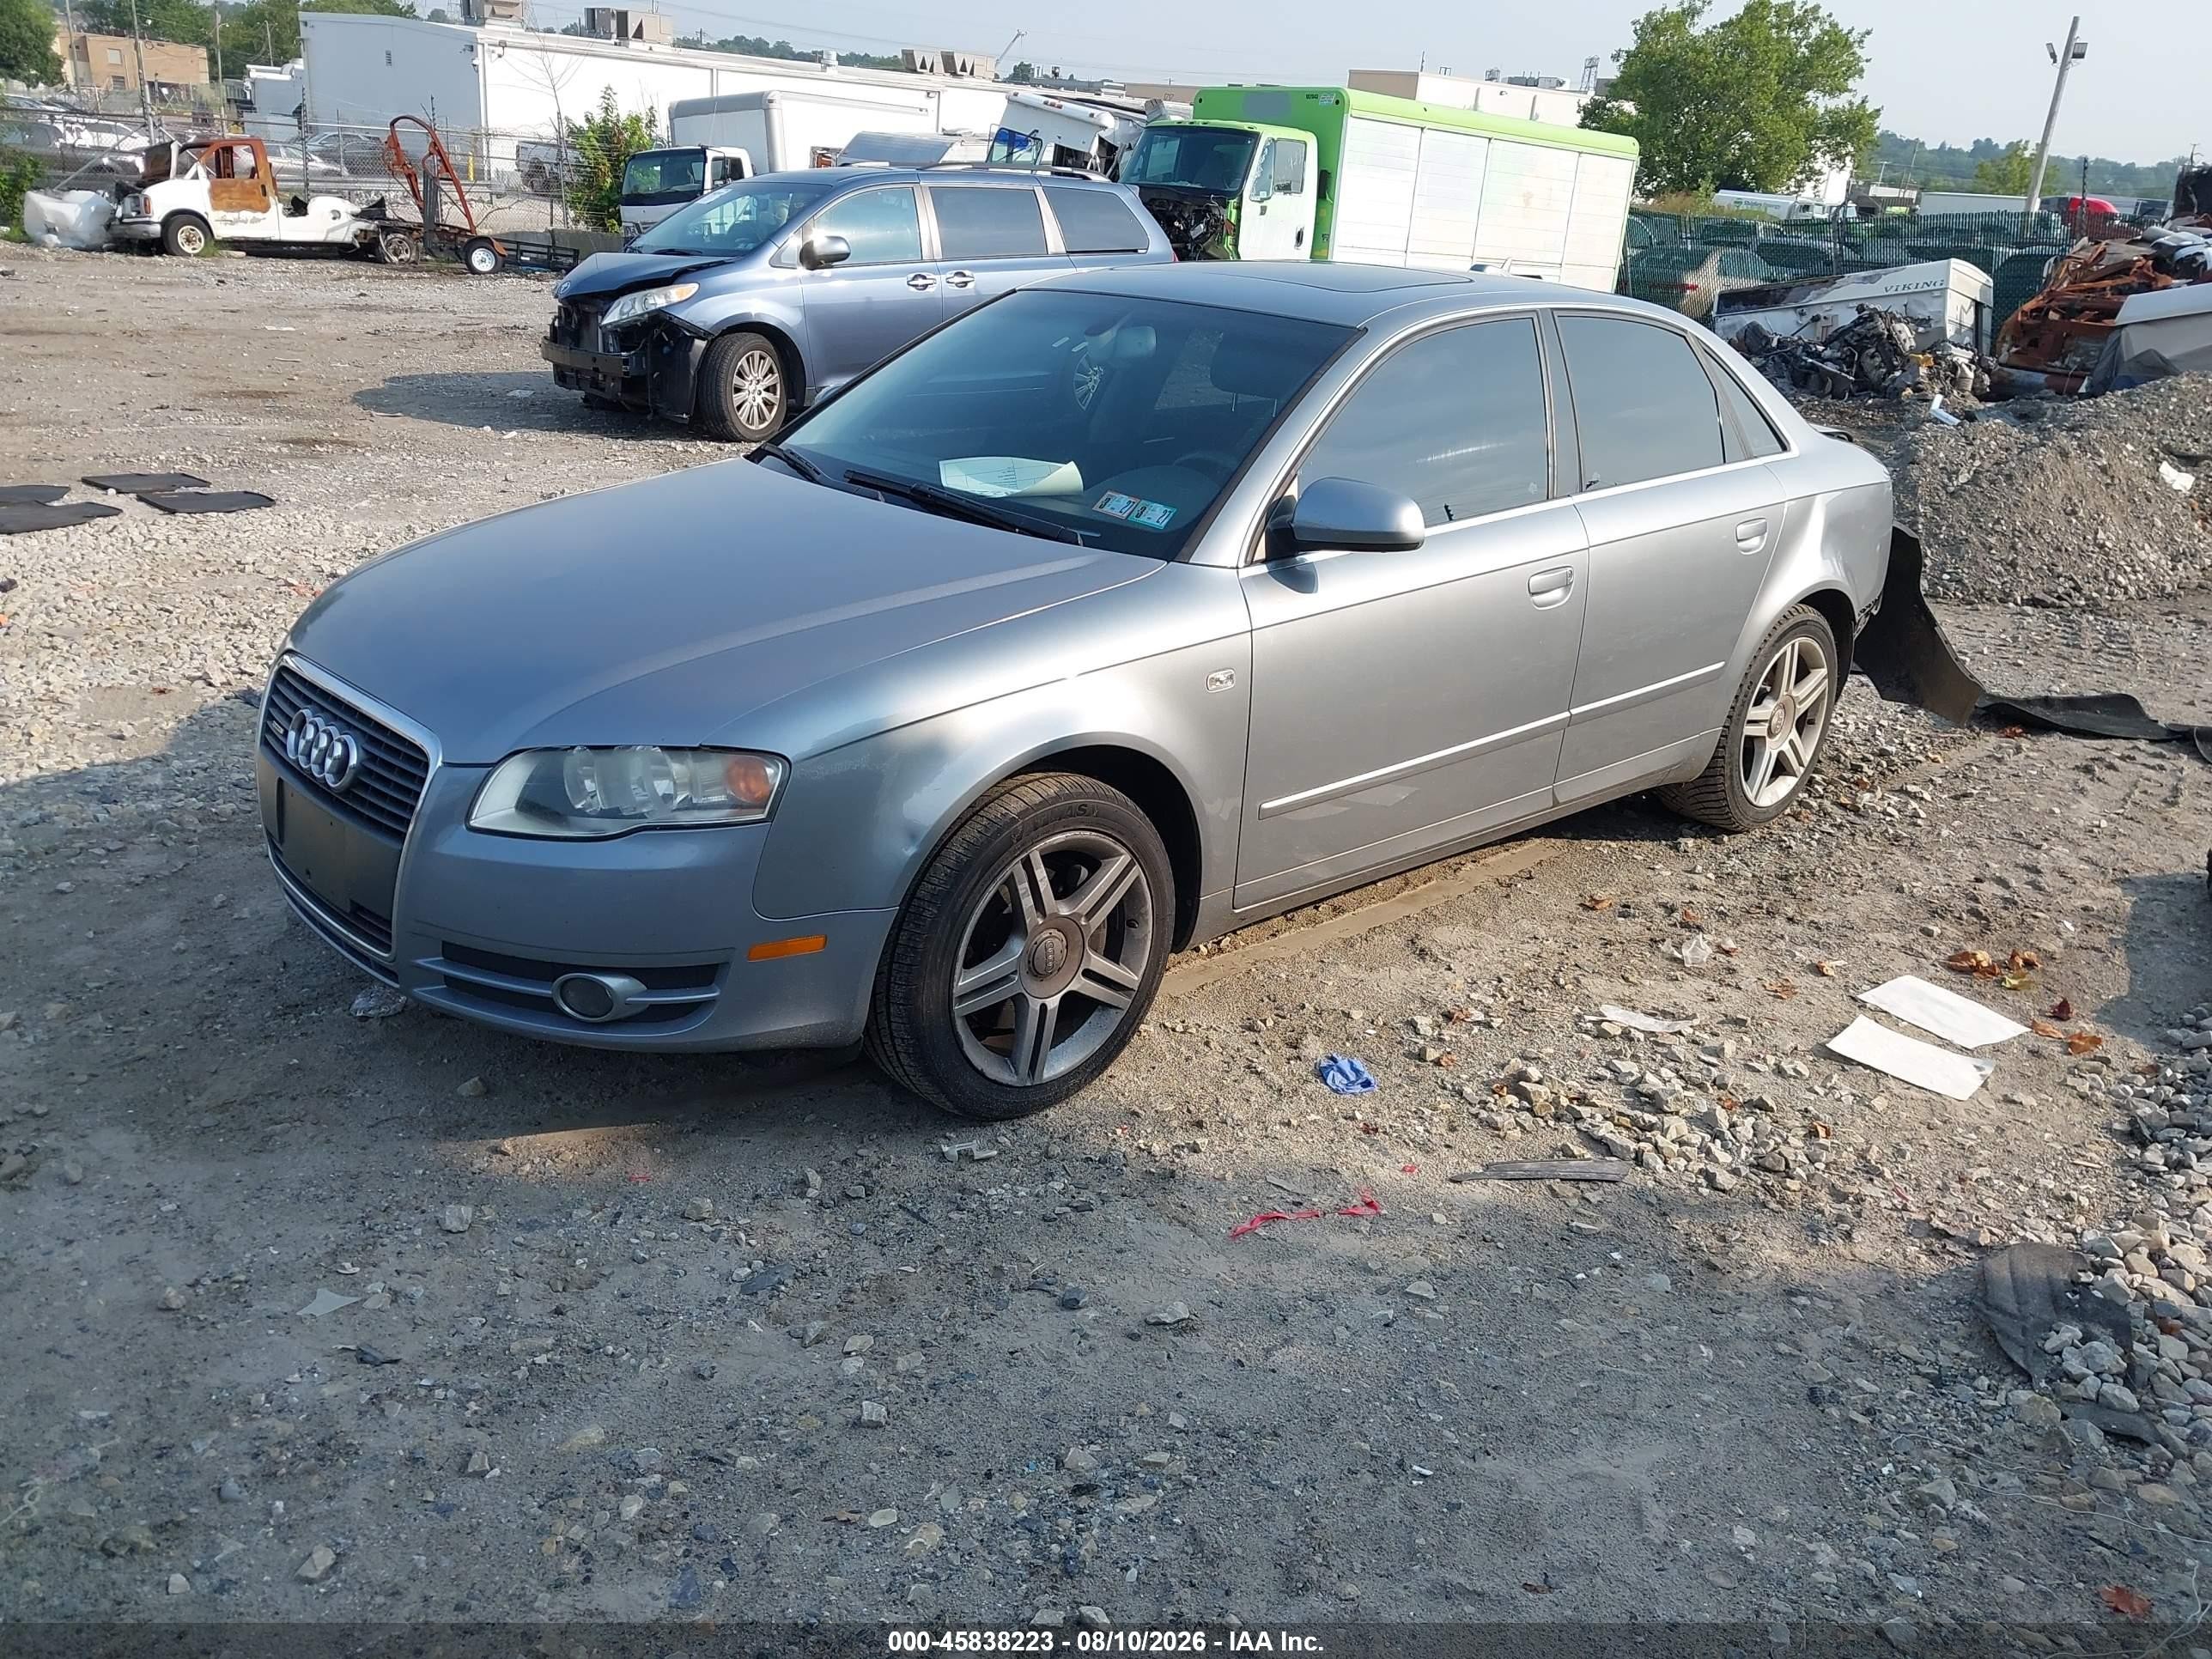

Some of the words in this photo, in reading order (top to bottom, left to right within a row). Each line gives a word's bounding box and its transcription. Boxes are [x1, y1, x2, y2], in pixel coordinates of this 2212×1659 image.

[1883, 279, 1944, 293] VIKING
[1098, 497, 1111, 509] 3
[1119, 500, 1135, 515] 27
[1135, 506, 1147, 519] 3
[1156, 509, 1172, 525] 27
